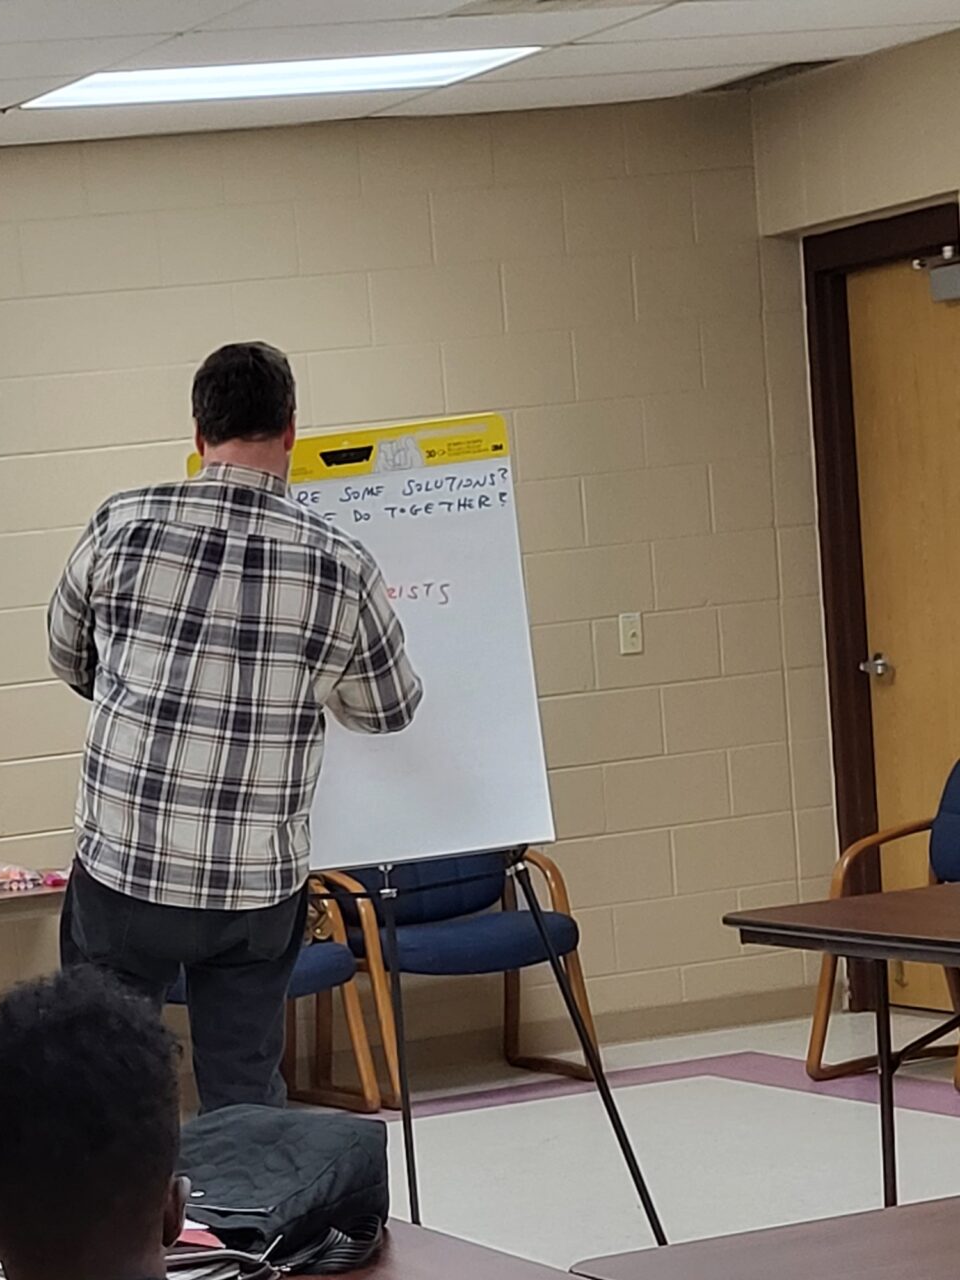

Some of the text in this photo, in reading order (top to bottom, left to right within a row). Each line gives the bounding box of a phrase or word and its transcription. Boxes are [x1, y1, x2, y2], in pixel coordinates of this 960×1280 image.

[295, 468, 508, 506] RE SOME SOLUTIONS?
[353, 509, 372, 522] DO
[384, 492, 508, 518] TOGETHER?
